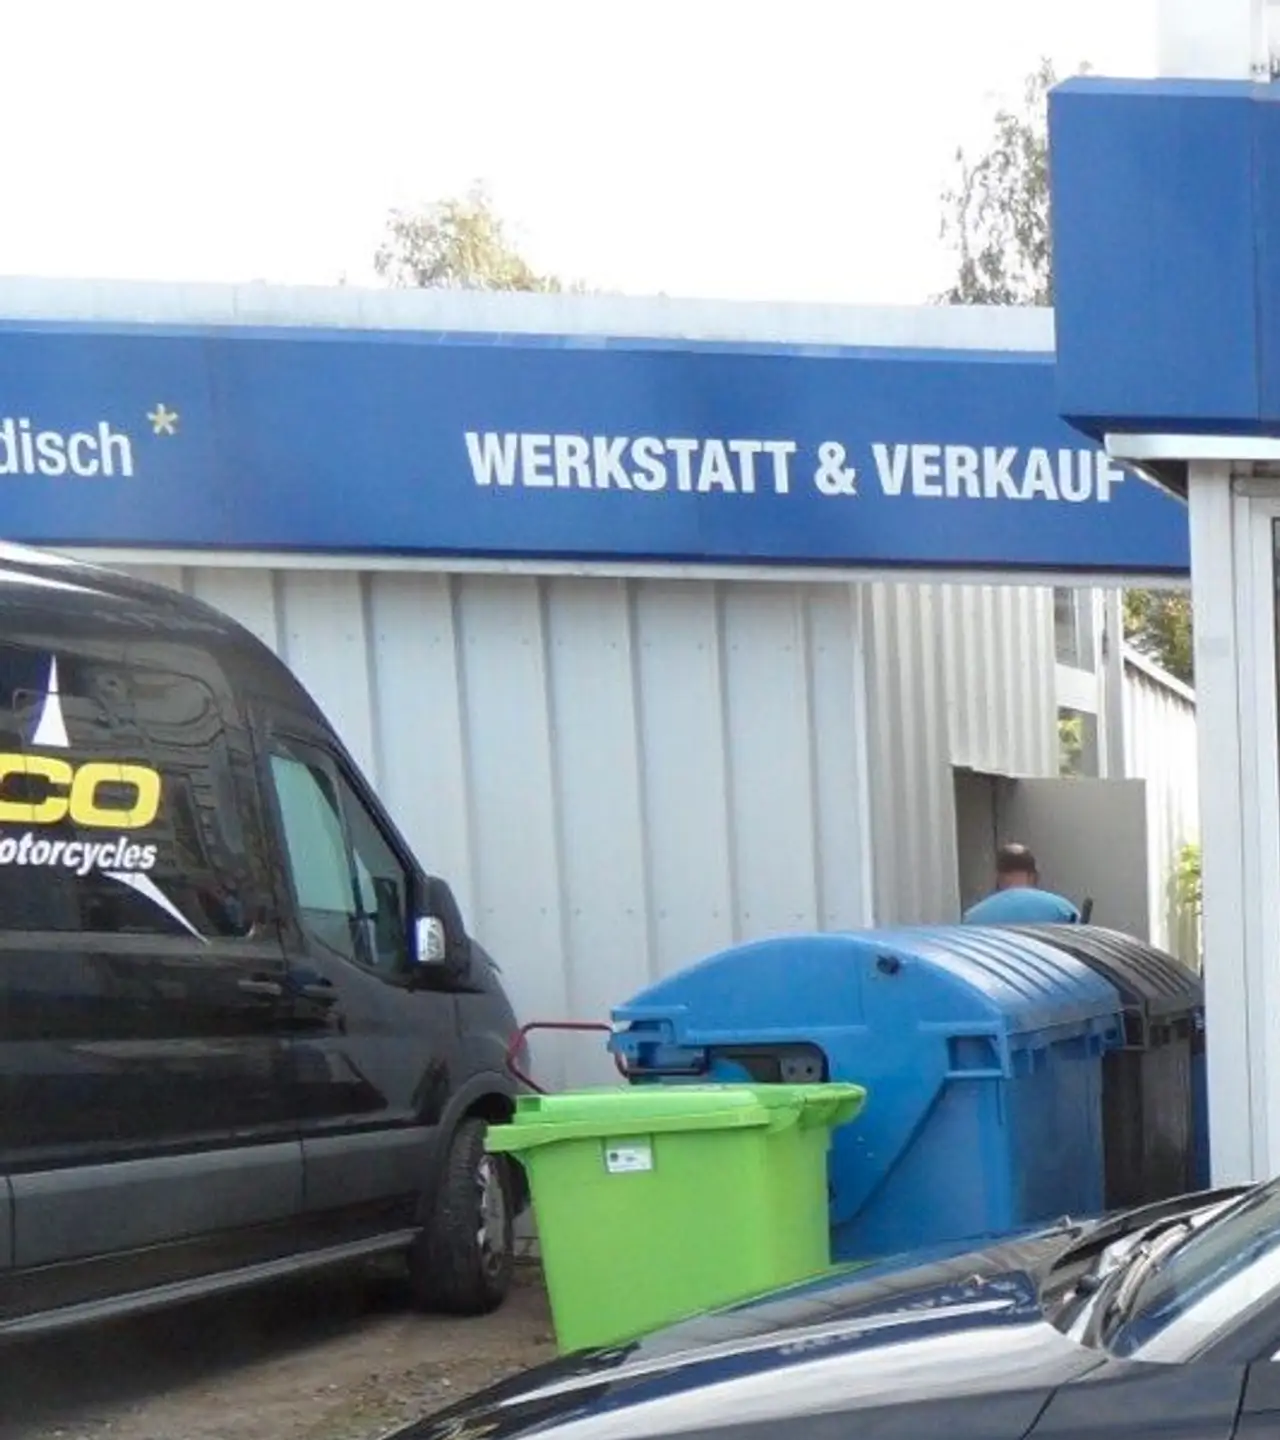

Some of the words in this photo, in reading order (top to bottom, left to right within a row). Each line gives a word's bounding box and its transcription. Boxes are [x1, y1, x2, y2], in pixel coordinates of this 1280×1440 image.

[464, 431, 797, 493] WERKSTATT
[814, 441, 857, 495] &
[870, 443, 1125, 503] VERKAUF
